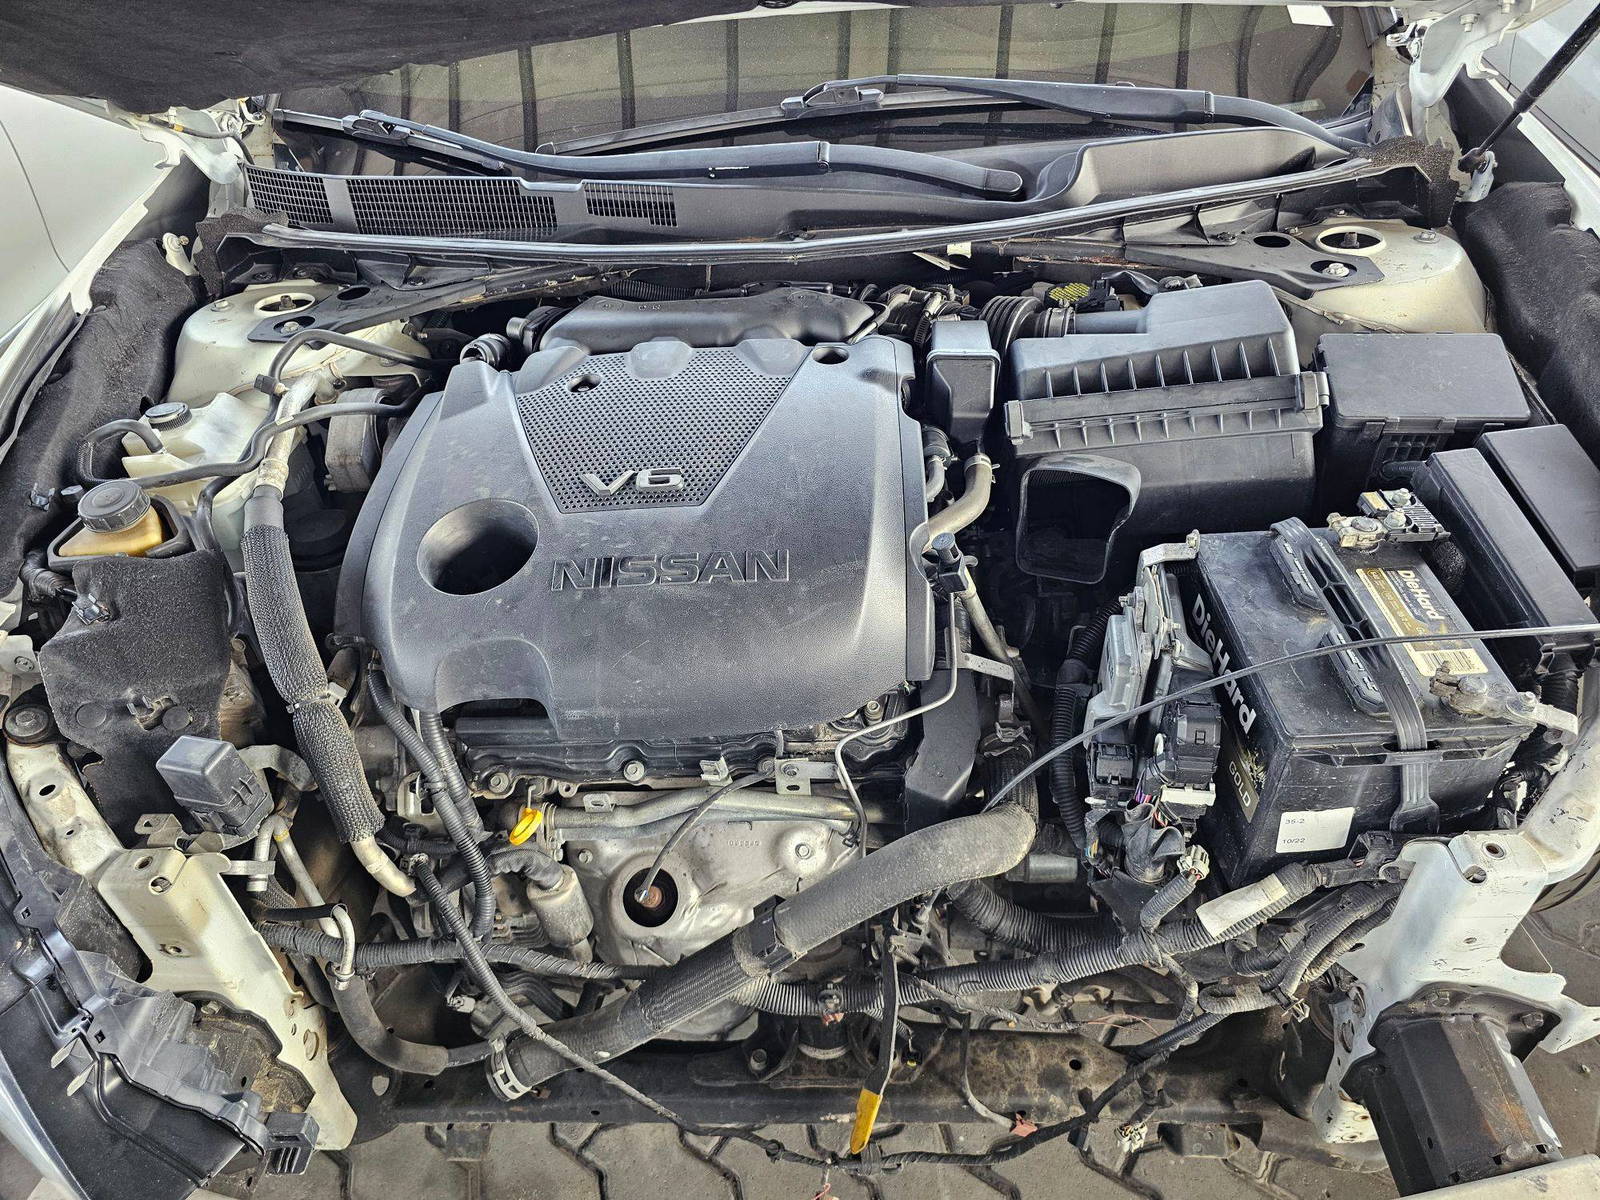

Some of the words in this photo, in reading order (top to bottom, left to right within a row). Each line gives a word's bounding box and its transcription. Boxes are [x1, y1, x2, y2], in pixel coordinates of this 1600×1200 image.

[579, 467, 685, 496] V6
[551, 549, 790, 592] NISSAN
[1397, 570, 1446, 621] DieHard
[1192, 593, 1257, 735] DieHard
[1229, 761, 1251, 807] GOLD
[1282, 837, 1306, 845] 10/22
